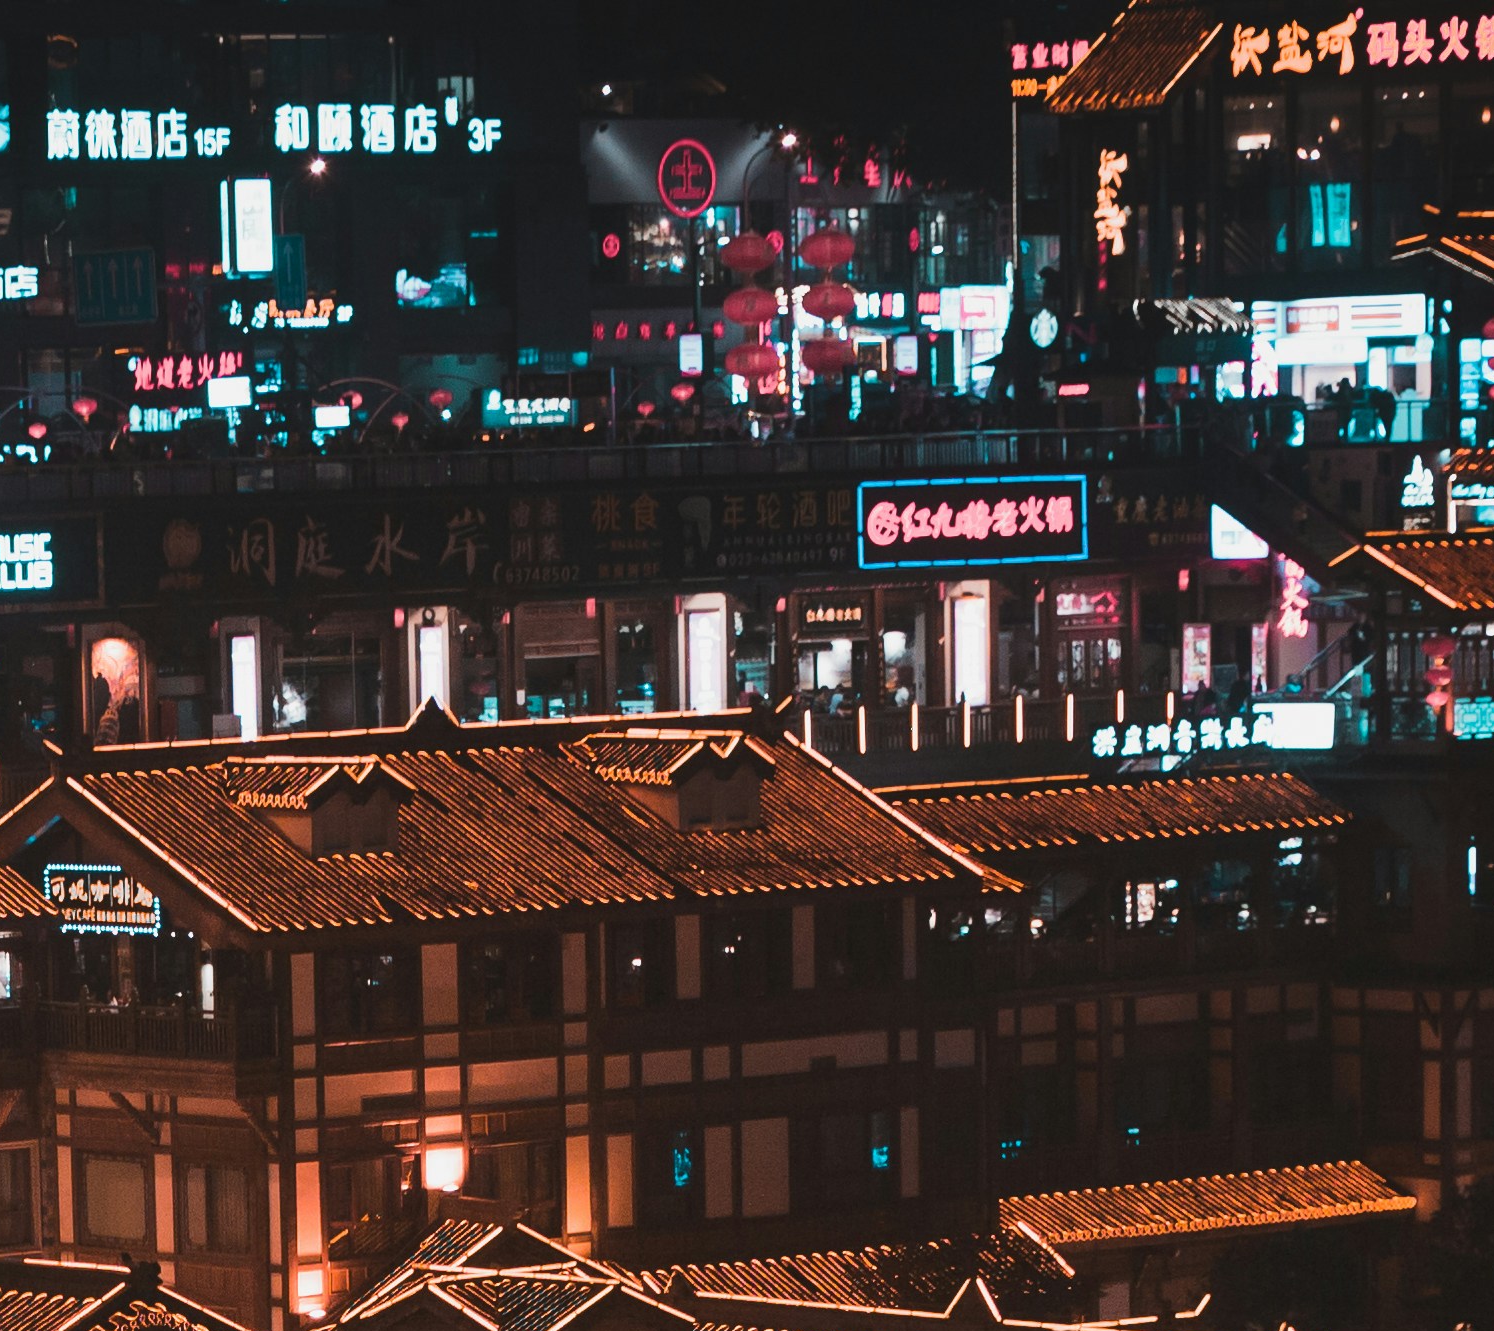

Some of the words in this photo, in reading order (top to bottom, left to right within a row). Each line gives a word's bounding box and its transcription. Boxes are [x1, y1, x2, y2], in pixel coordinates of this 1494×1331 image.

[194, 127, 231, 157] 15F
[275, 103, 437, 153] 和颐酒店
[468, 118, 502, 152] 3F
[723, 490, 852, 529] 年轮酒吧
[227, 505, 490, 587] 洞庭水岸
